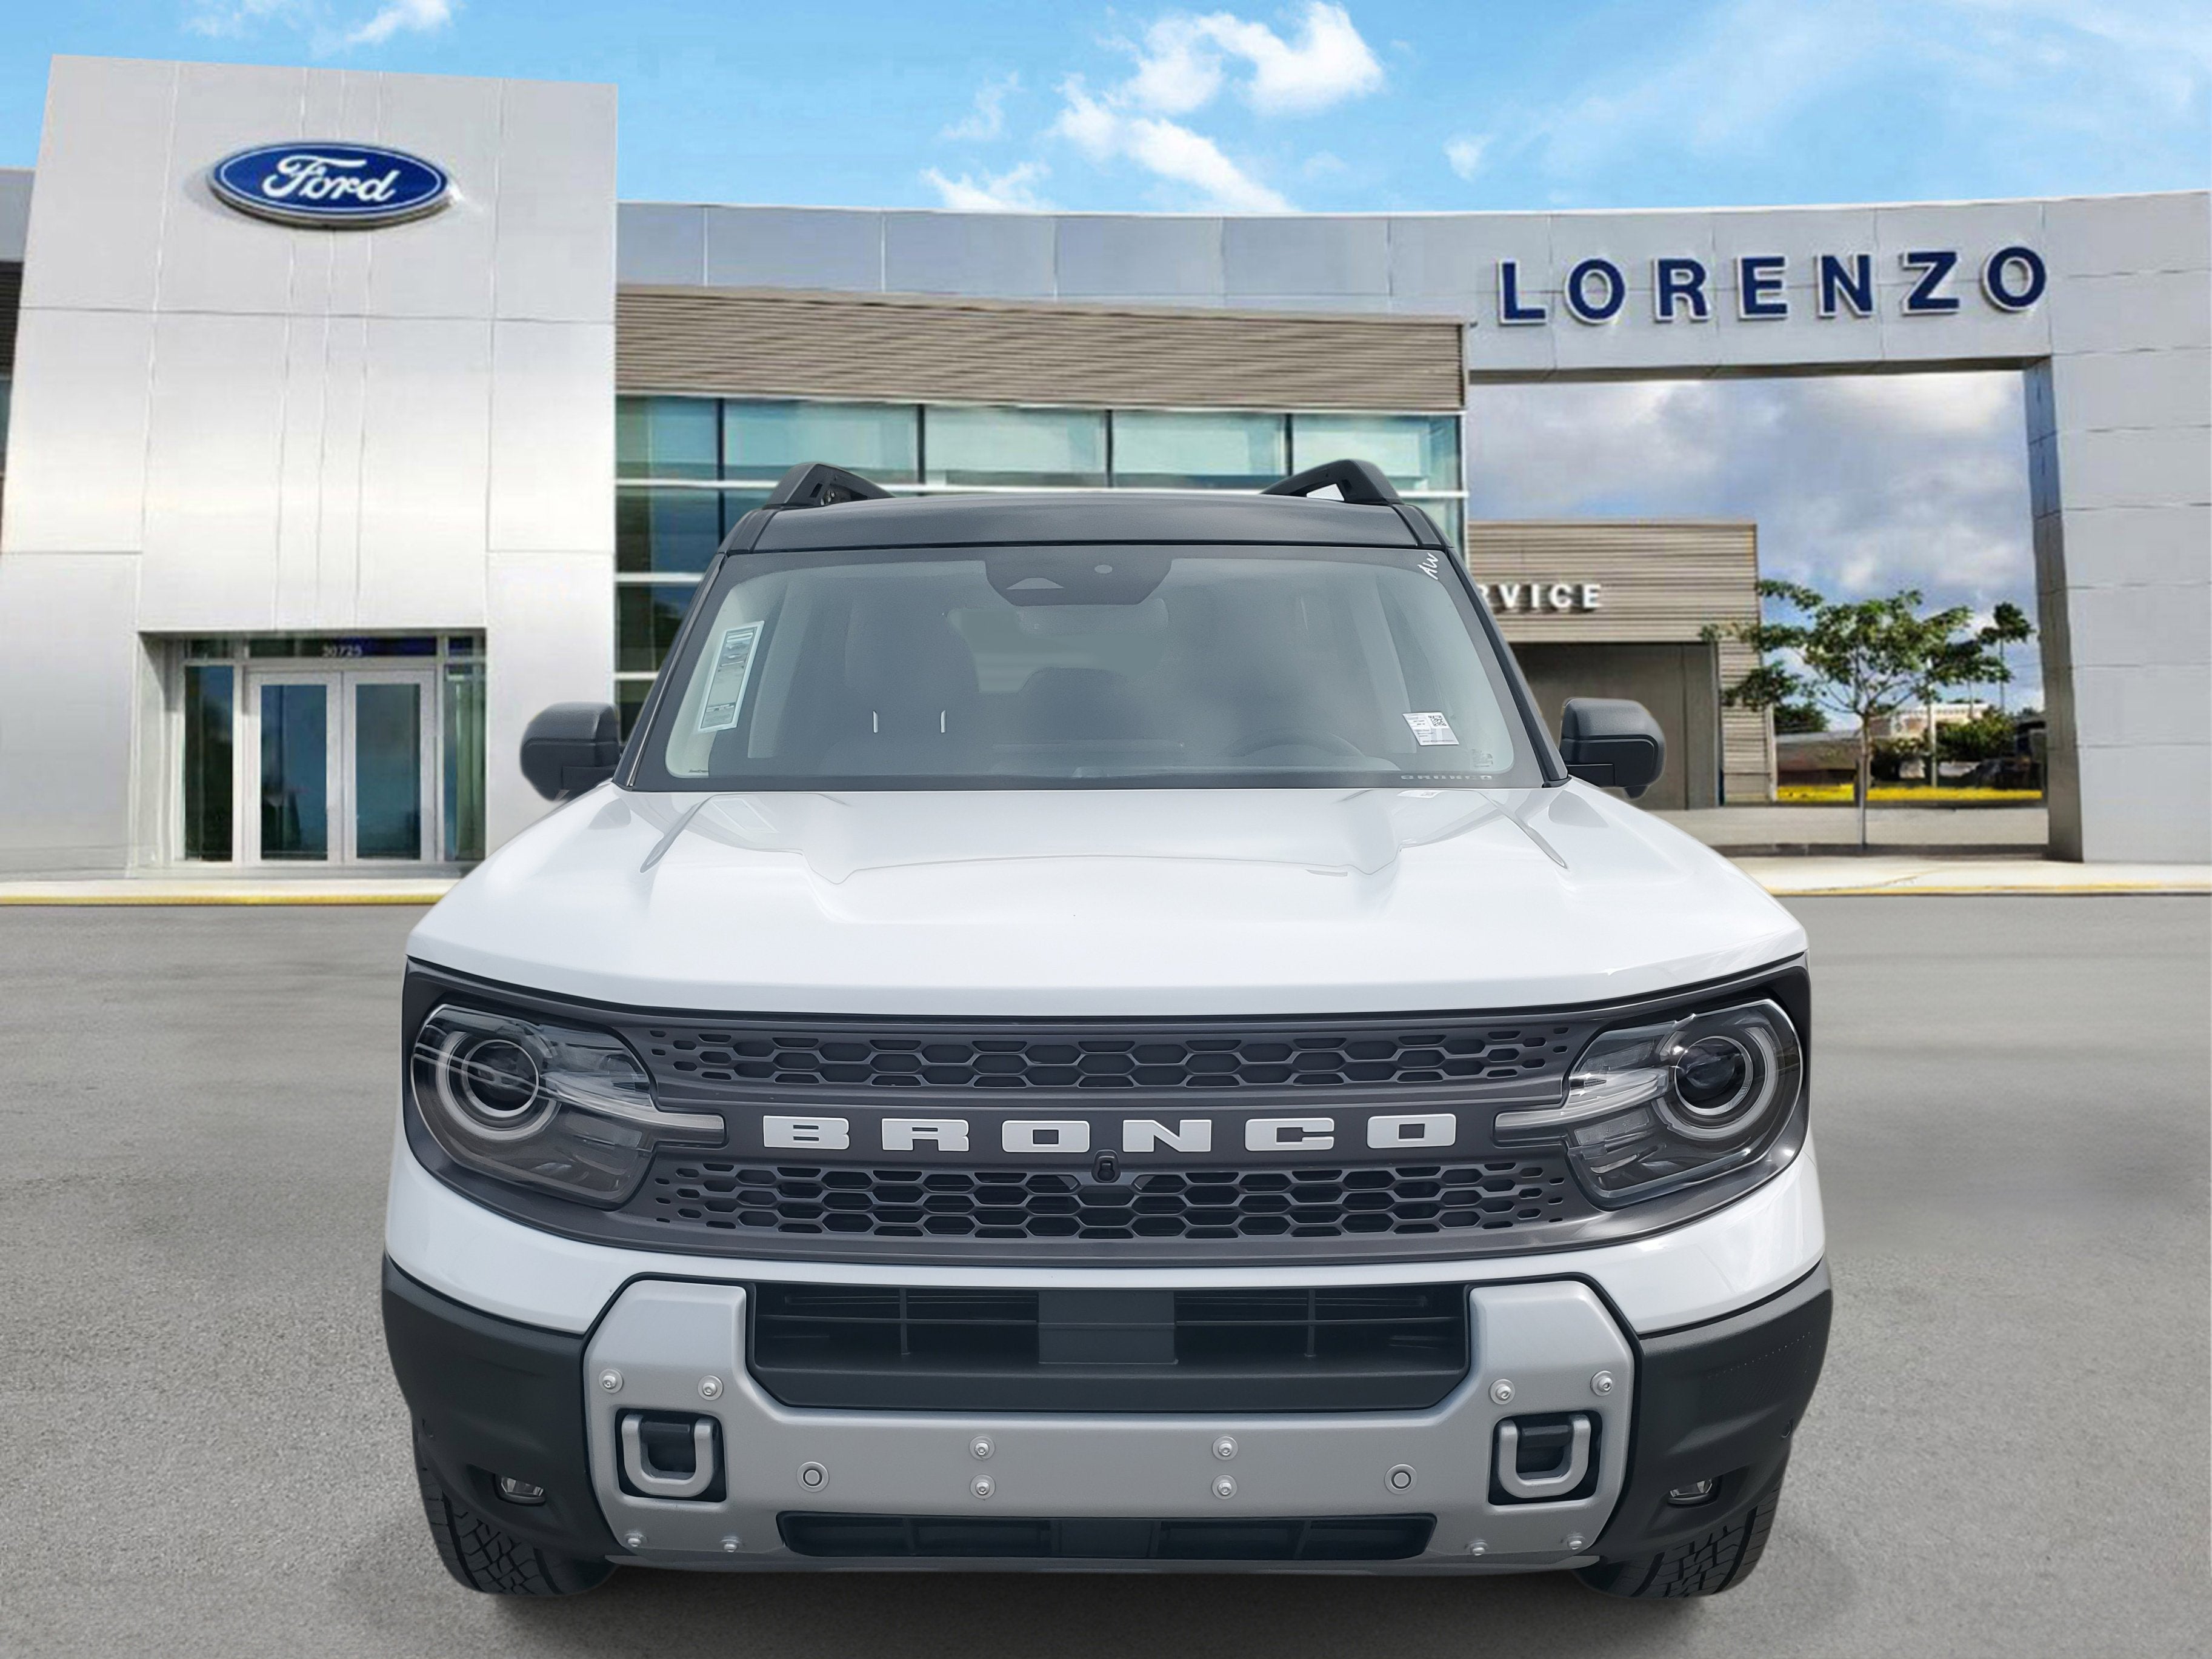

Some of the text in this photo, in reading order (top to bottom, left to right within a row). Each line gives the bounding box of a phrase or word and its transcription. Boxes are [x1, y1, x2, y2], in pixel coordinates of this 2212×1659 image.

[262, 155, 401, 201] Ford
[1499, 246, 2047, 325] LORENZO
[763, 1113, 1456, 1152] BRONCO
